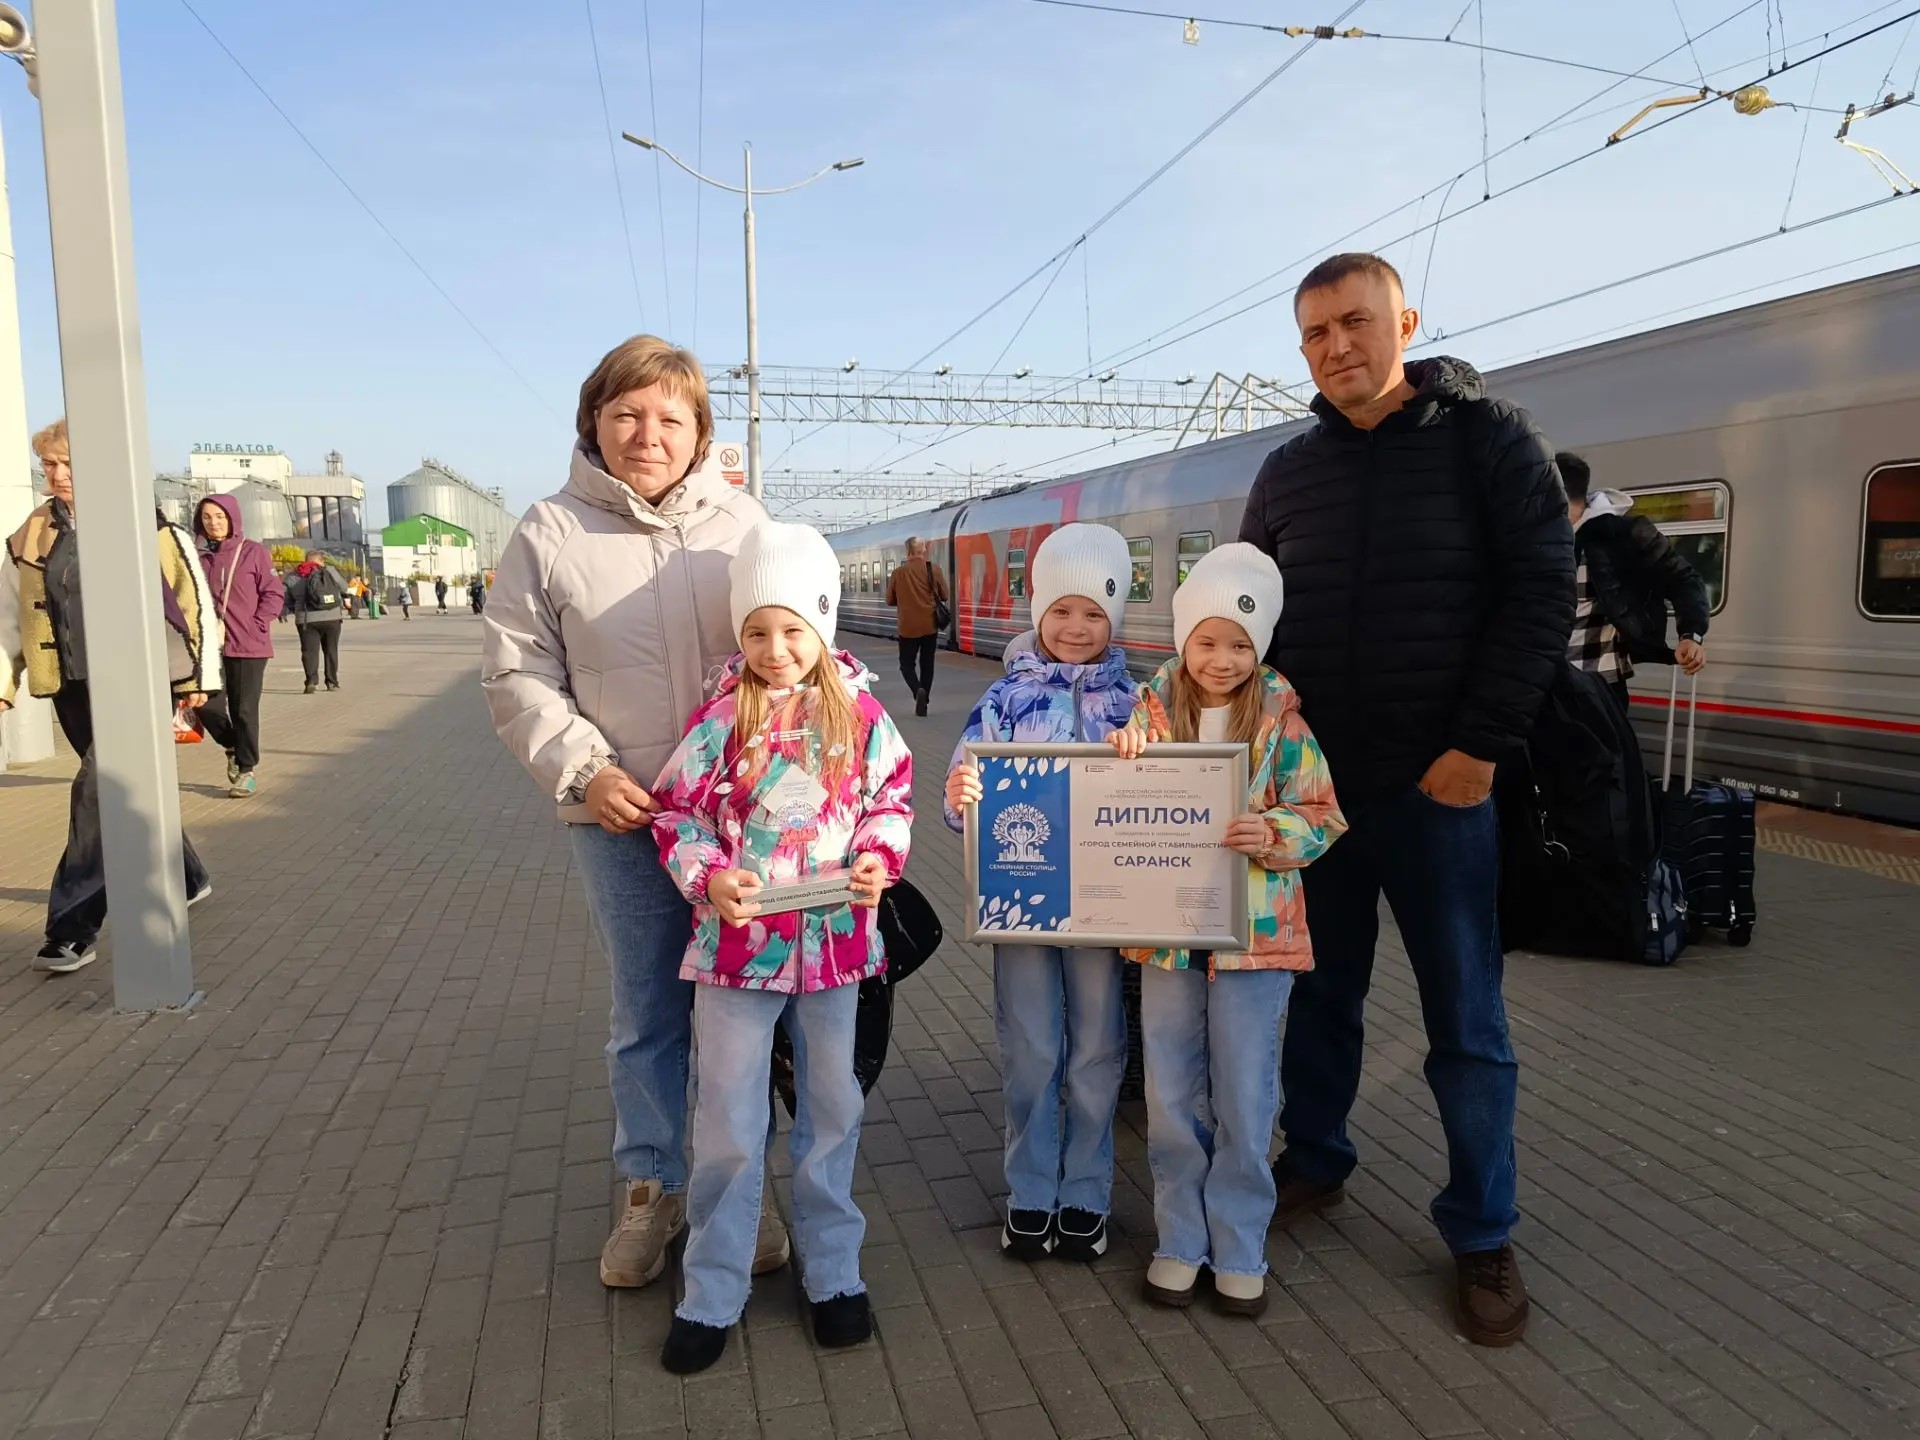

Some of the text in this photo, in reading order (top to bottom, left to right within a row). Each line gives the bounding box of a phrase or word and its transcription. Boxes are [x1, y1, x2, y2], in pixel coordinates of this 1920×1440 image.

[193, 443, 274, 453] ЭЛЕВАТОР
[1095, 807, 1210, 826] ДИПЛОМ
[1112, 840, 1157, 848] СЕМЕЙНОЙ
[1114, 856, 1192, 868] САРАНСК
